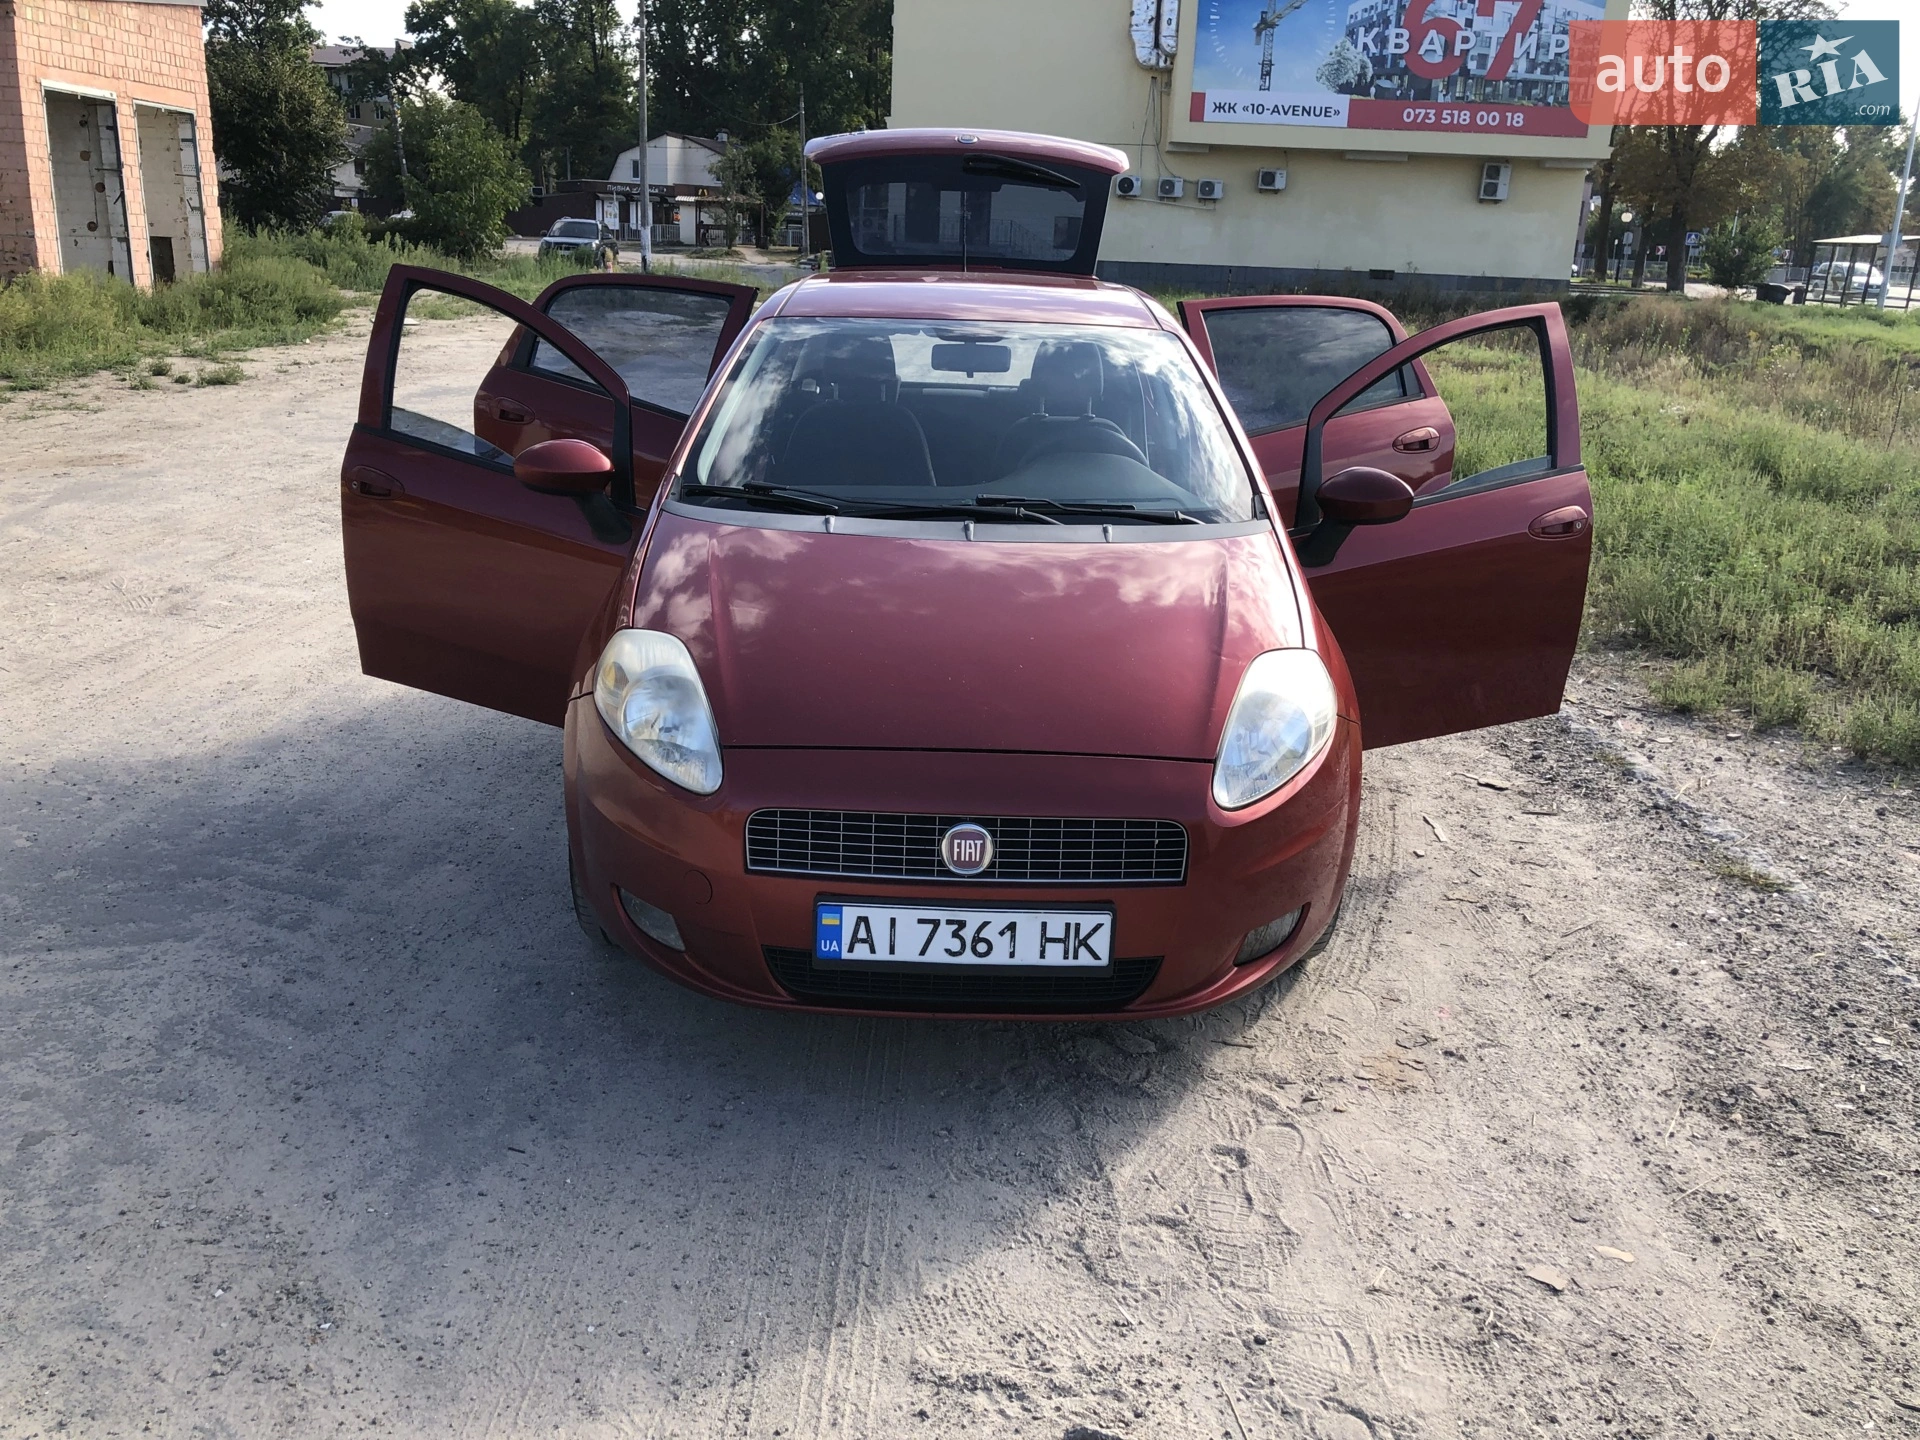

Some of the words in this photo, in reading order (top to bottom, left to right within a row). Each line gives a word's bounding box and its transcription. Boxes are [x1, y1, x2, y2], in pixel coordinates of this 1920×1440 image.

[1357, 27, 1570, 60] КВАРТИР
[1402, 0, 1544, 80] 67
[1212, 101, 1237, 115] ЖК
[1242, 102, 1341, 119] «10-AVENUE»
[1402, 107, 1436, 124] 073
[1440, 109, 1471, 125] 518
[1476, 110, 1500, 126] 00
[1505, 112, 1525, 127] 18
[953, 839, 983, 862] FIAT
[821, 940, 839, 952] UA
[847, 915, 896, 955] AI
[916, 918, 1017, 958] 7361
[1039, 921, 1105, 960] HK
